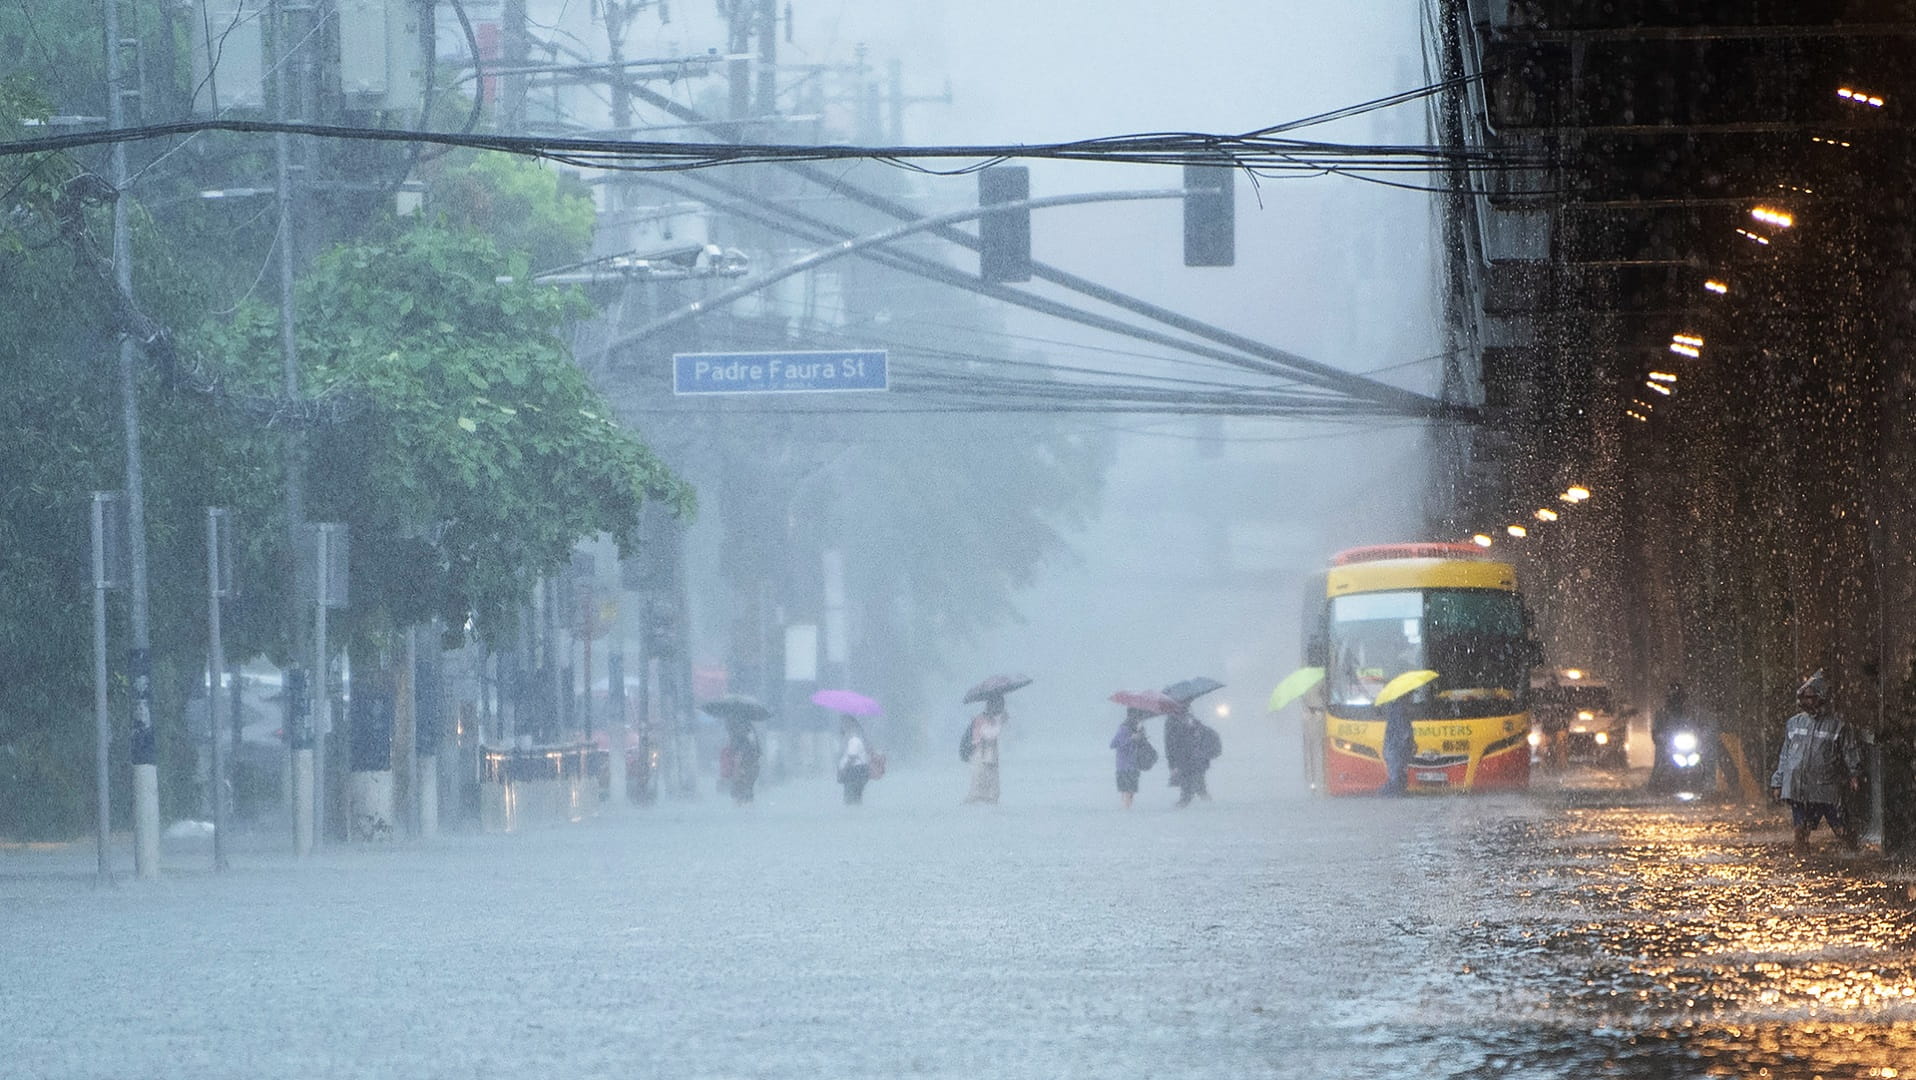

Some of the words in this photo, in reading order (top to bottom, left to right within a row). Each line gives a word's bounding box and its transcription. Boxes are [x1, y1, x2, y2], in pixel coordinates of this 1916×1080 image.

[695, 361, 762, 381] Padre
[769, 360, 835, 379] Faura
[842, 358, 865, 377] St
